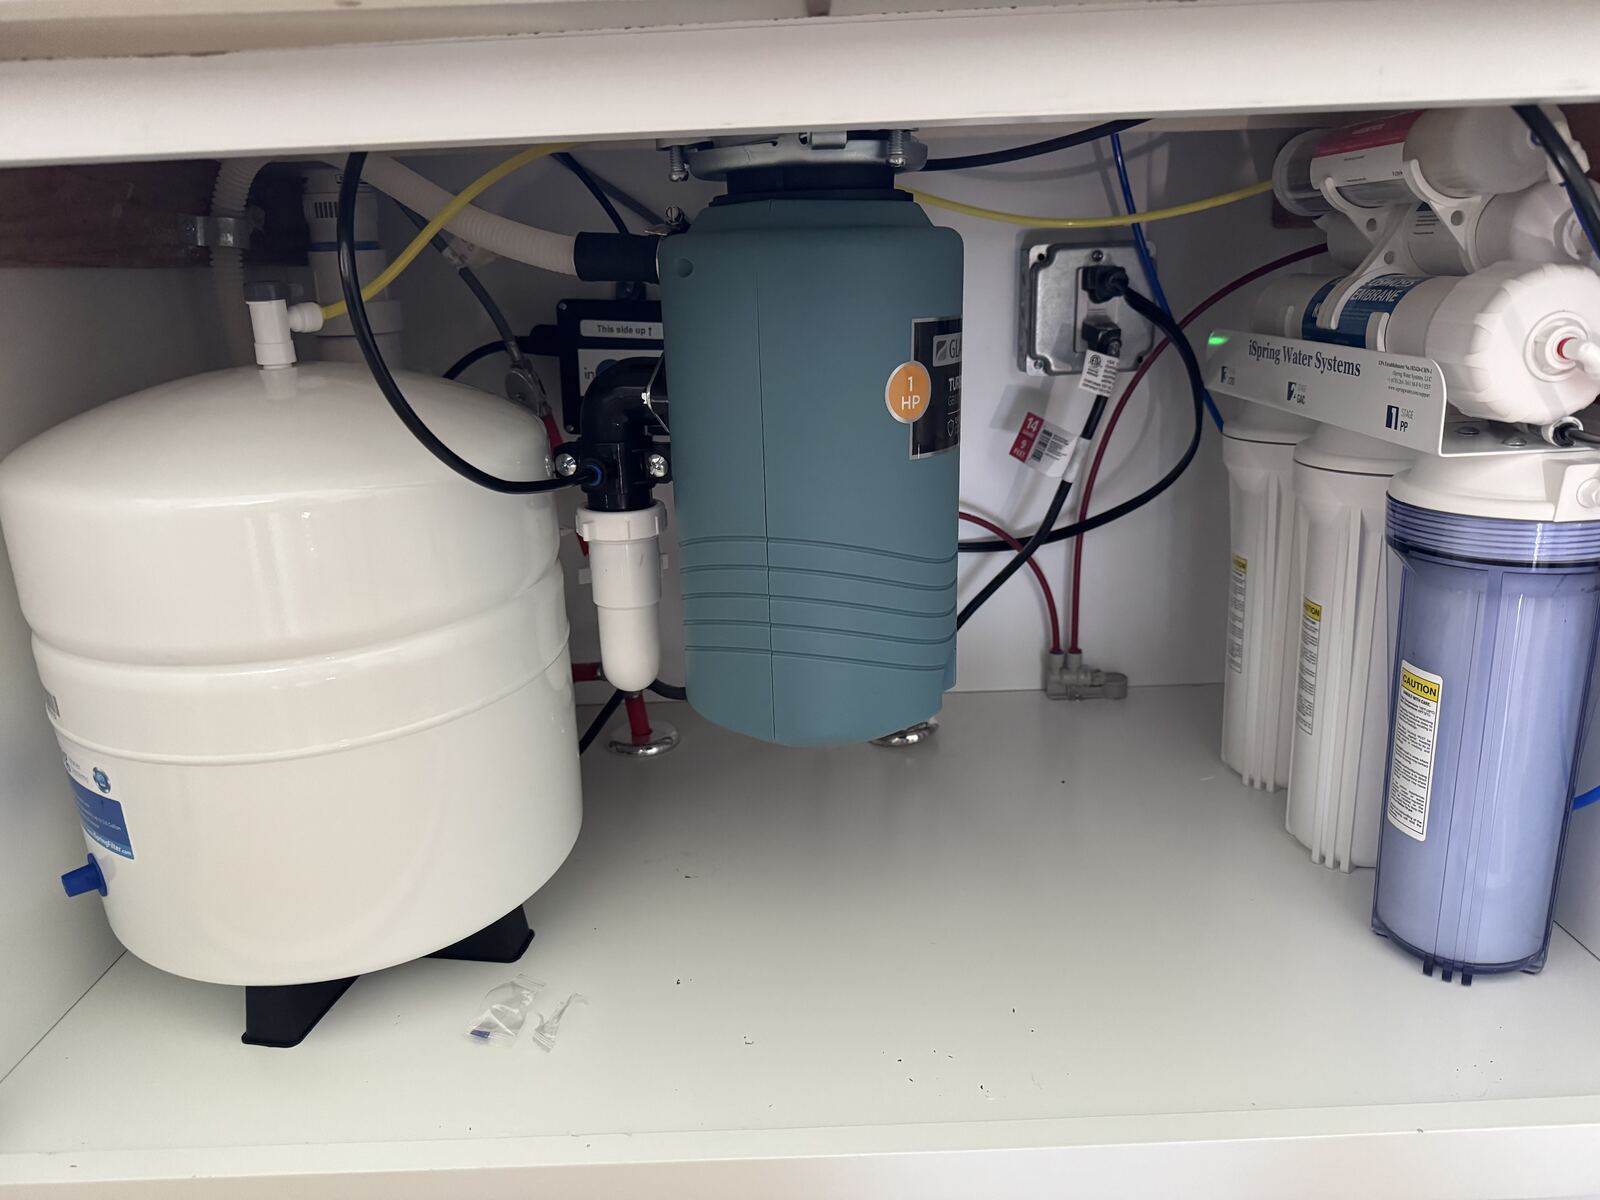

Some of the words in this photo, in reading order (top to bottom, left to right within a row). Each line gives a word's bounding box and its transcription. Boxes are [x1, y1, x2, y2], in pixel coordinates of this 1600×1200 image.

[1350, 288, 1404, 302] EMBRANE
[597, 324, 615, 333] This
[616, 325, 634, 334] side
[635, 327, 646, 336] up
[1248, 339, 1281, 366] iSpring
[1282, 345, 1313, 367] Water
[1314, 351, 1361, 377] Systems
[907, 376, 914, 392] 1
[901, 395, 921, 410] HP
[1400, 420, 1409, 432] PP
[1402, 674, 1437, 697] CAUTION
